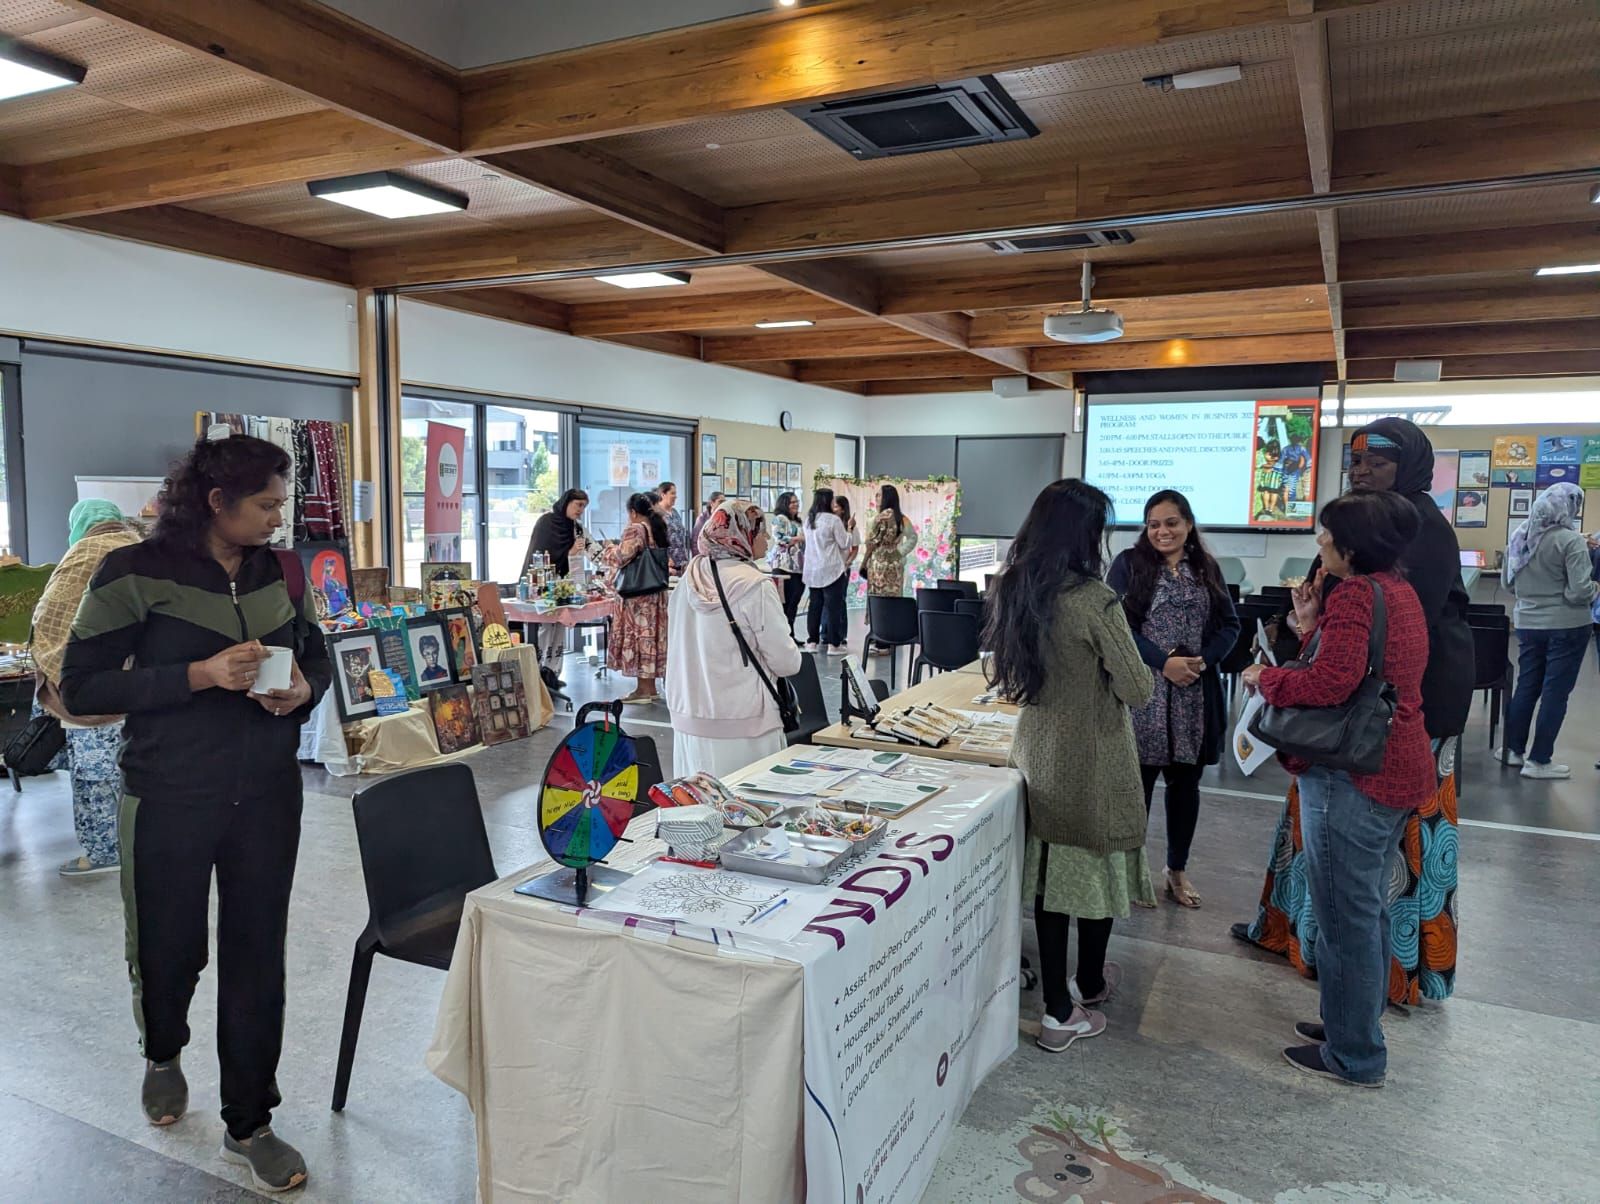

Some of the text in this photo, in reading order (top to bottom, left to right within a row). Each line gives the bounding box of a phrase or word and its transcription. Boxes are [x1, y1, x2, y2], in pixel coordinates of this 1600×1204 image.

[1203, 412, 1238, 420] BUSINESS
[1223, 432, 1249, 440] PUBLIC
[802, 832, 954, 952] NDIS
[979, 852, 993, 870] Stage
[843, 941, 923, 1028] Assist-Travel/Transport
[844, 904, 937, 1001] Assist Prod-Pers Care/Safety
[843, 983, 904, 1055] Household Tasks
[845, 1050, 863, 1082] Daily
[887, 995, 911, 1032] Shared
[911, 977, 930, 1005] Living
[847, 1007, 924, 1108] Group/Centre Activities
[871, 1119, 900, 1165] information
